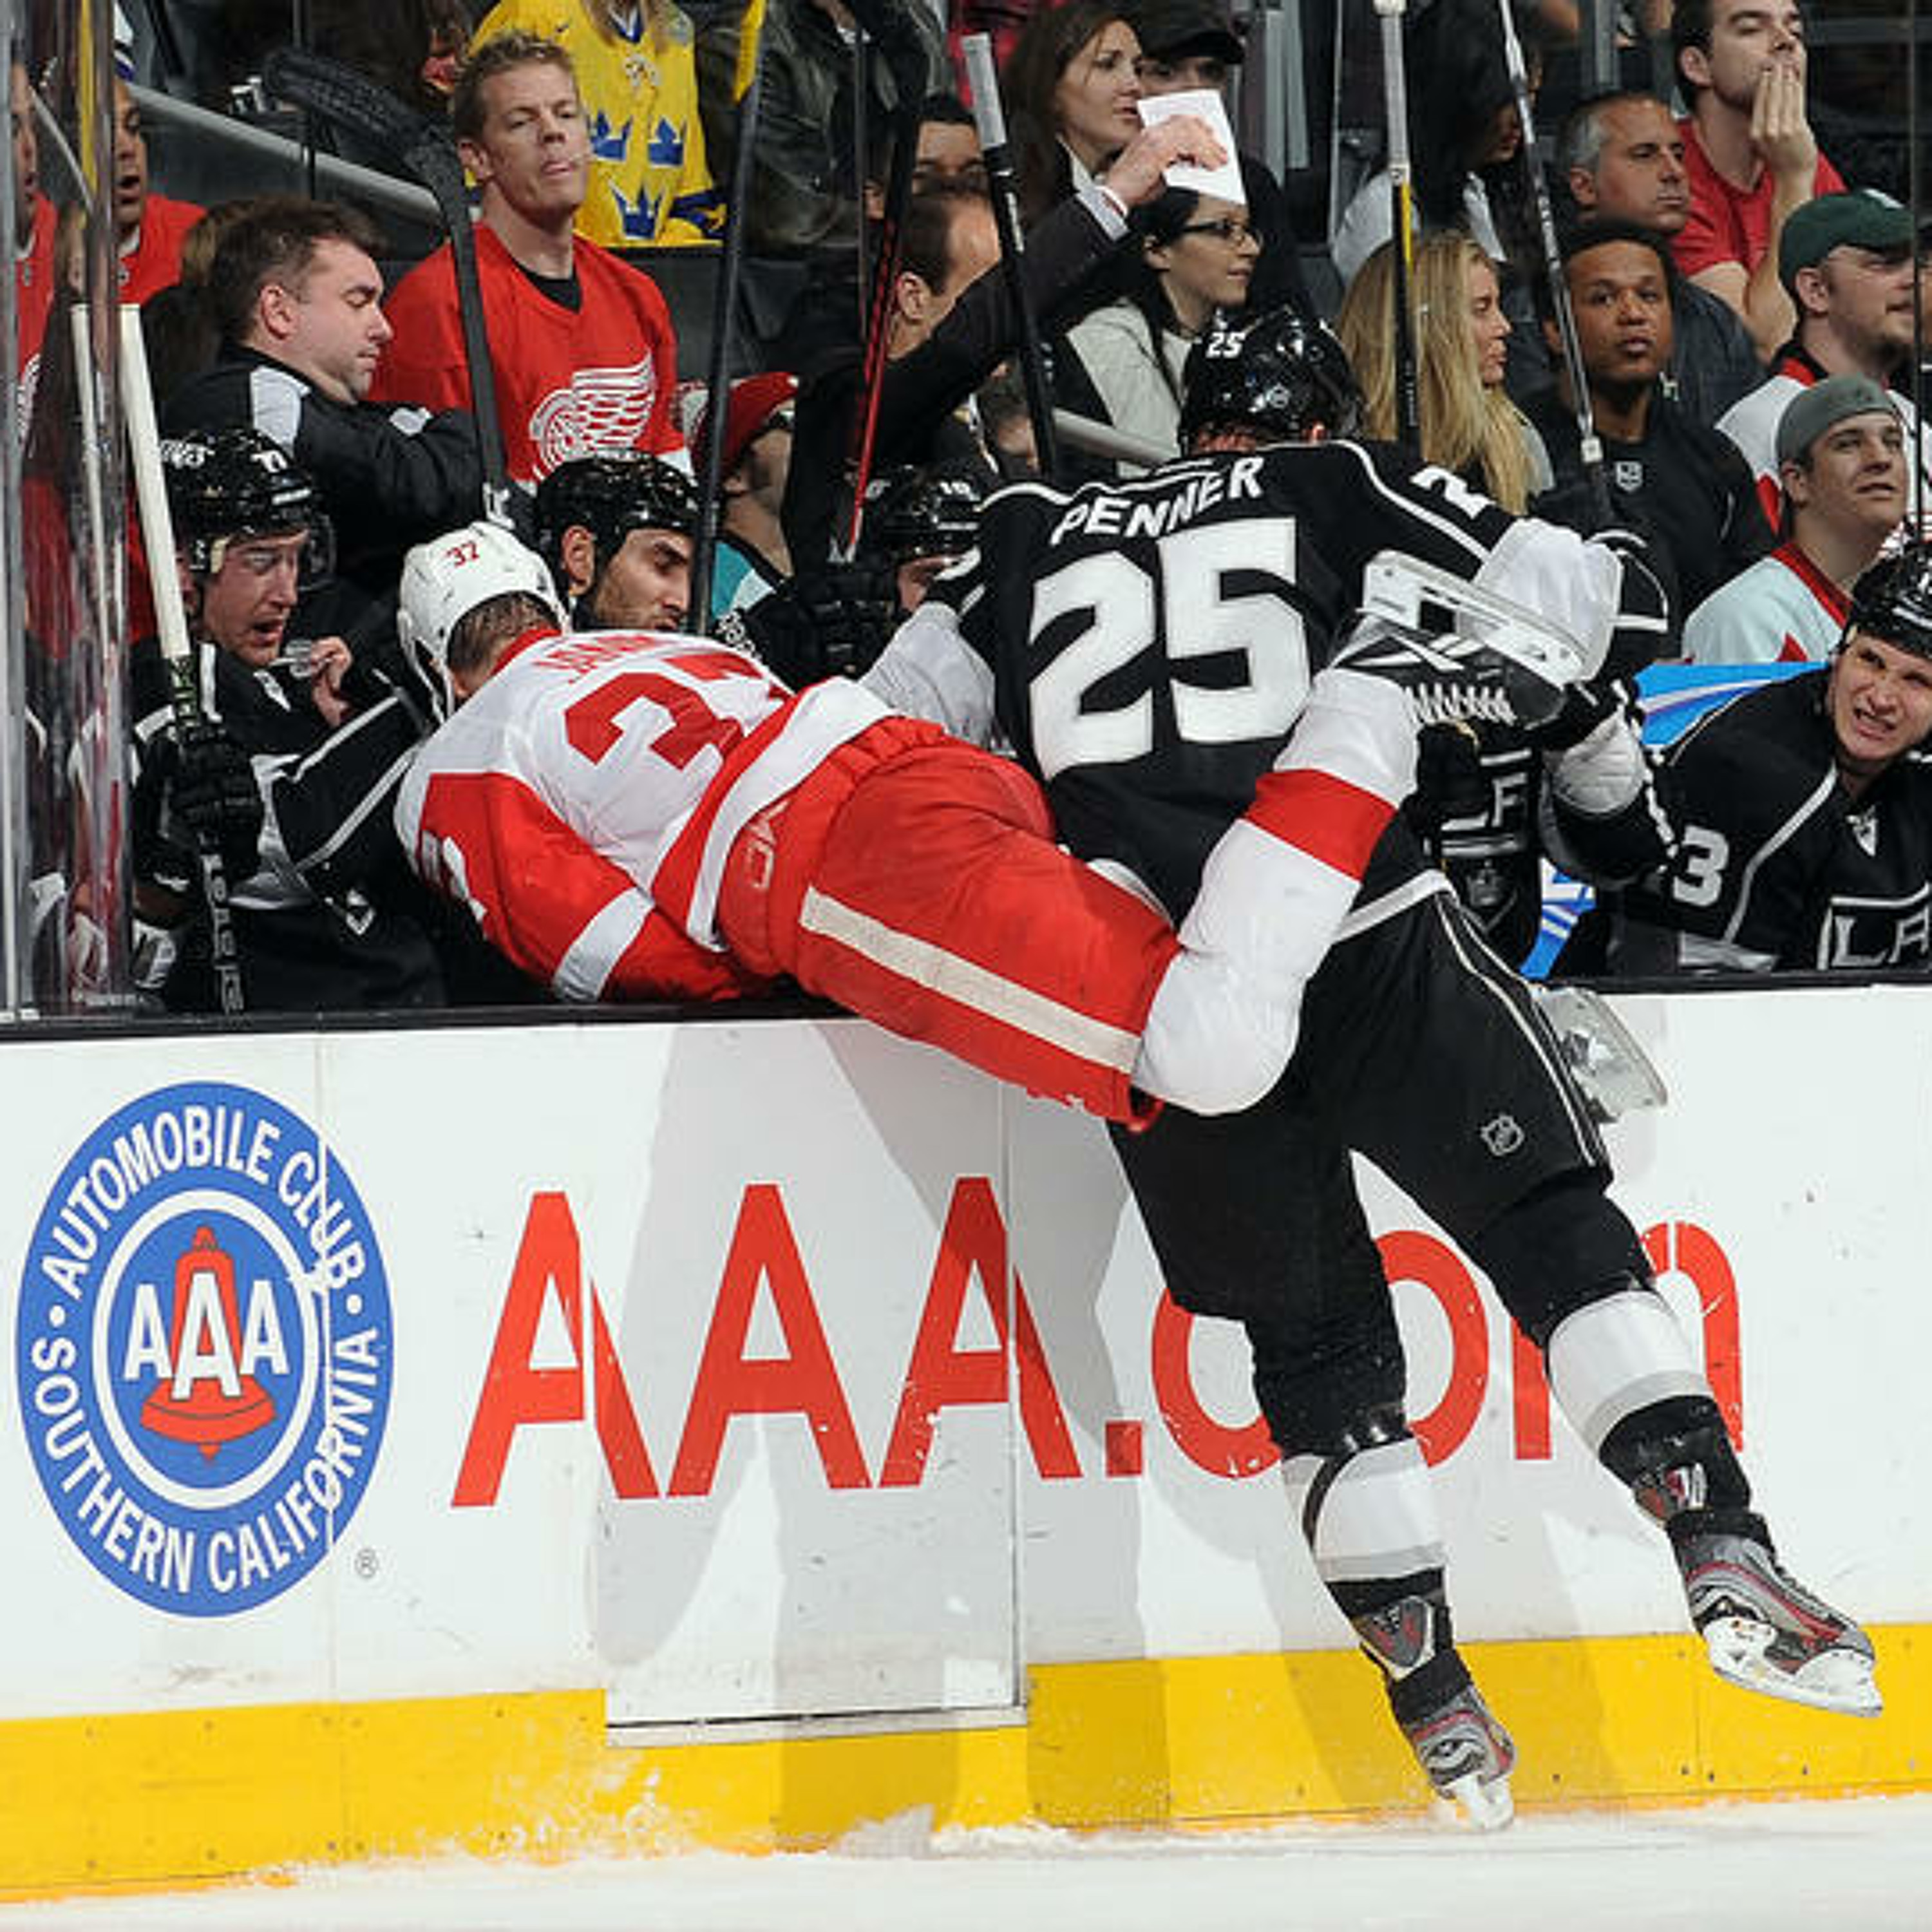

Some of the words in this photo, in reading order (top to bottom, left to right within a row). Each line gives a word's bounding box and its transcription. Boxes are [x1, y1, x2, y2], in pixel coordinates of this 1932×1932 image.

[1206, 331, 1247, 358] 25
[444, 540, 480, 568] 37
[1050, 457, 1264, 545] PENNER
[1028, 517, 1312, 782] 25
[42, 1106, 280, 1300] AUTOMOBILE
[278, 1151, 366, 1291] CLUB
[123, 1271, 290, 1400] AAA
[31, 1336, 196, 1595] SOUTHERN
[207, 1327, 380, 1594] CALIFORNIA
